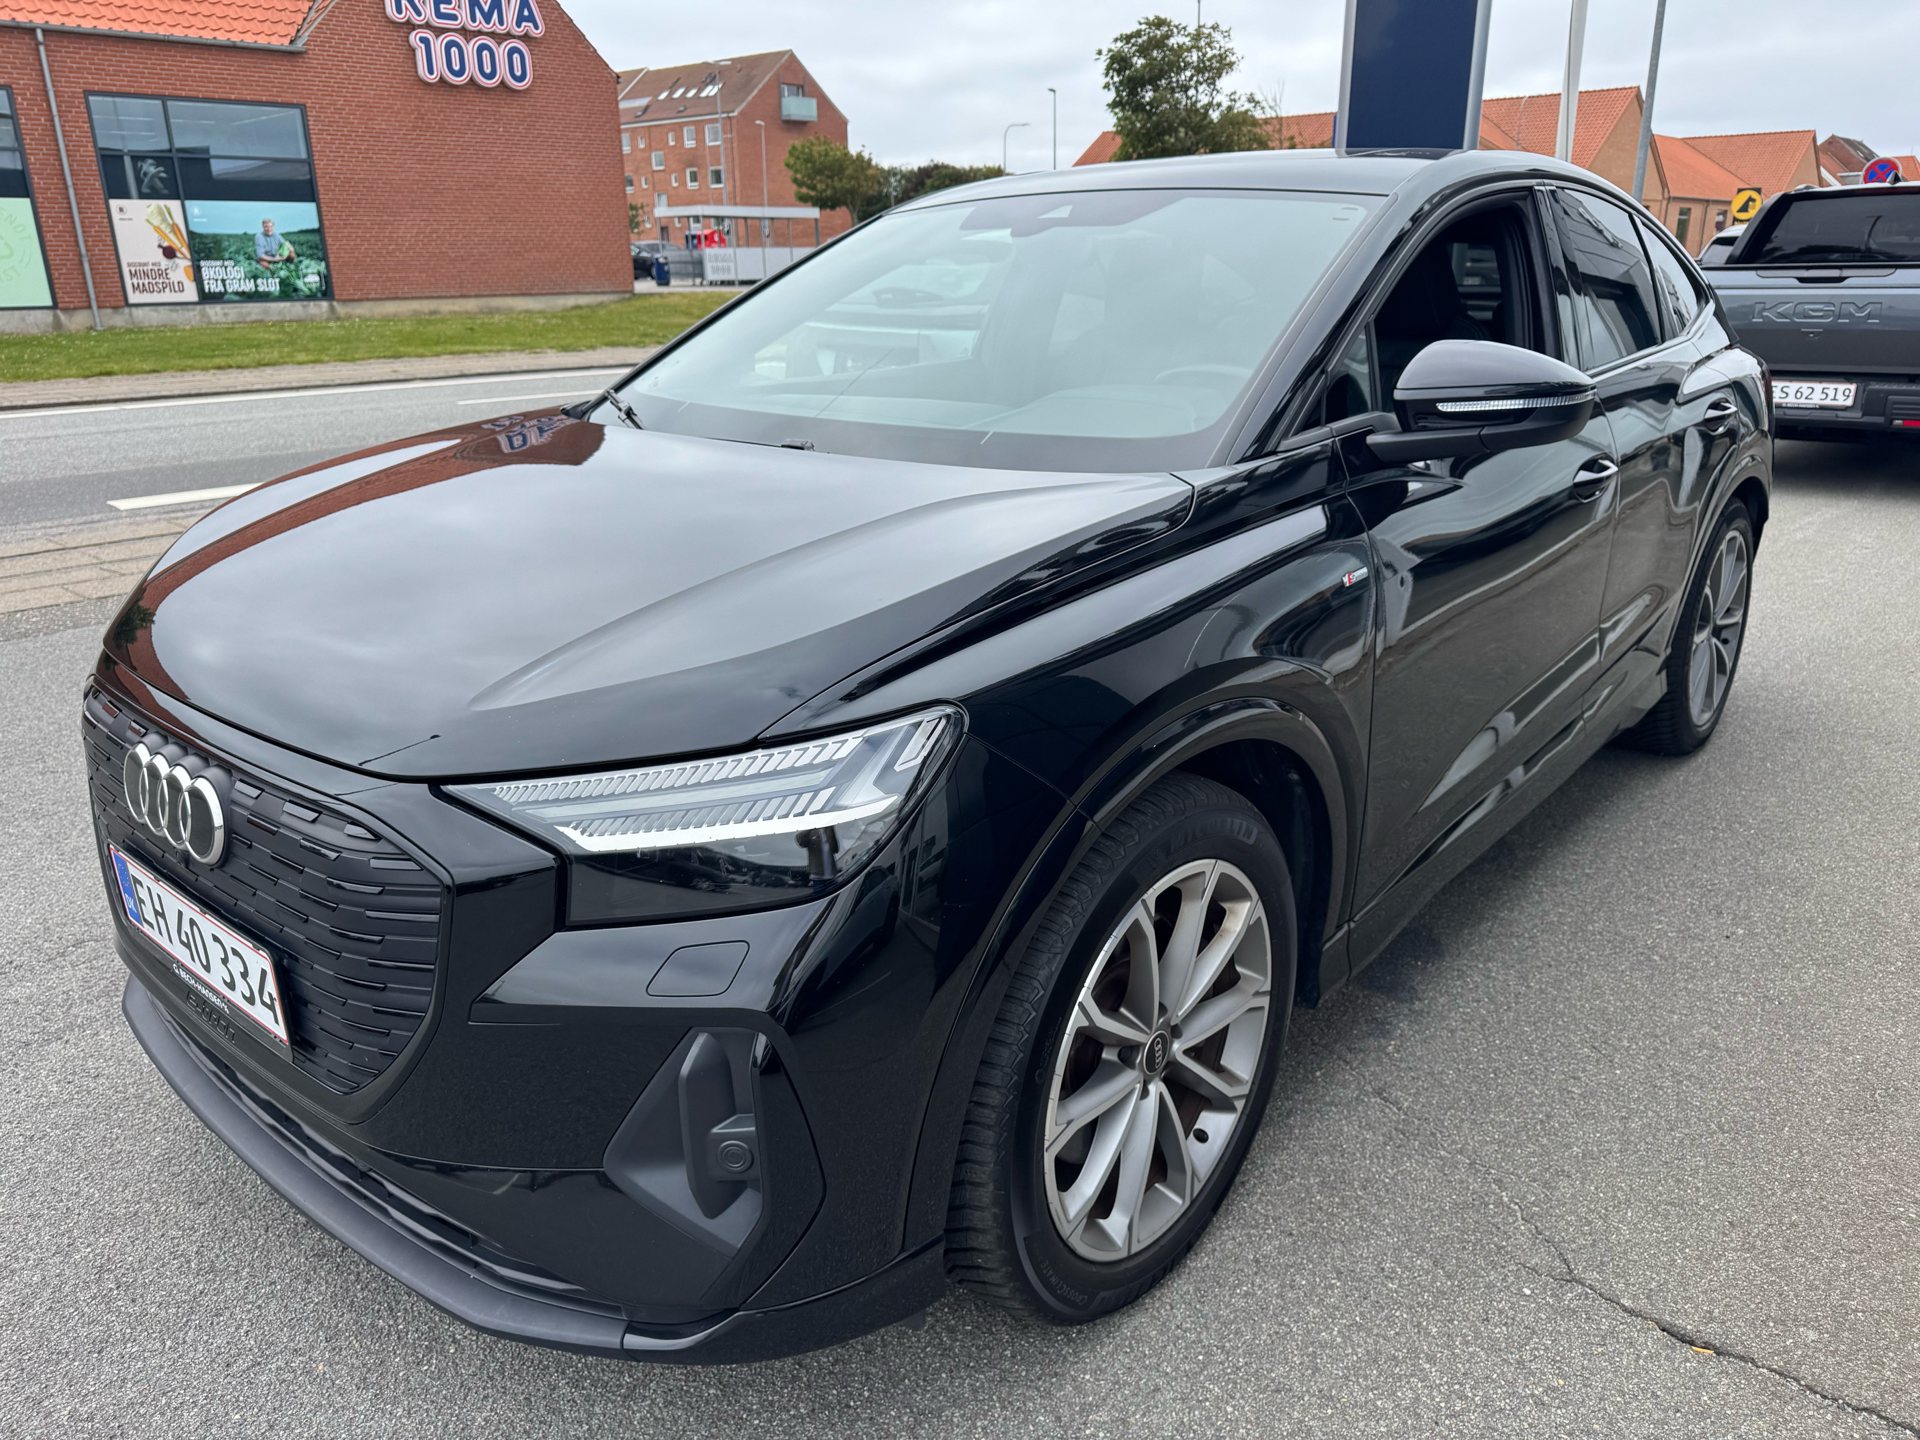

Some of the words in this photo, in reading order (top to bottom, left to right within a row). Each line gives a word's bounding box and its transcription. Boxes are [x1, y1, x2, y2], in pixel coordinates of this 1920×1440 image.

[409, 29, 534, 90] 1000
[129, 268, 171, 281] MINDRE
[201, 266, 245, 280] ØKOLOGI
[131, 281, 185, 294] MADSPILD
[203, 279, 225, 293] FRA
[225, 278, 255, 292] GRAM
[256, 277, 280, 292] SLOT
[1751, 301, 1883, 323] KGM
[1794, 386, 1815, 401] 62
[1819, 387, 1852, 402] 519
[130, 872, 174, 945] EH
[176, 908, 212, 975] 40
[211, 932, 281, 1027] 334
